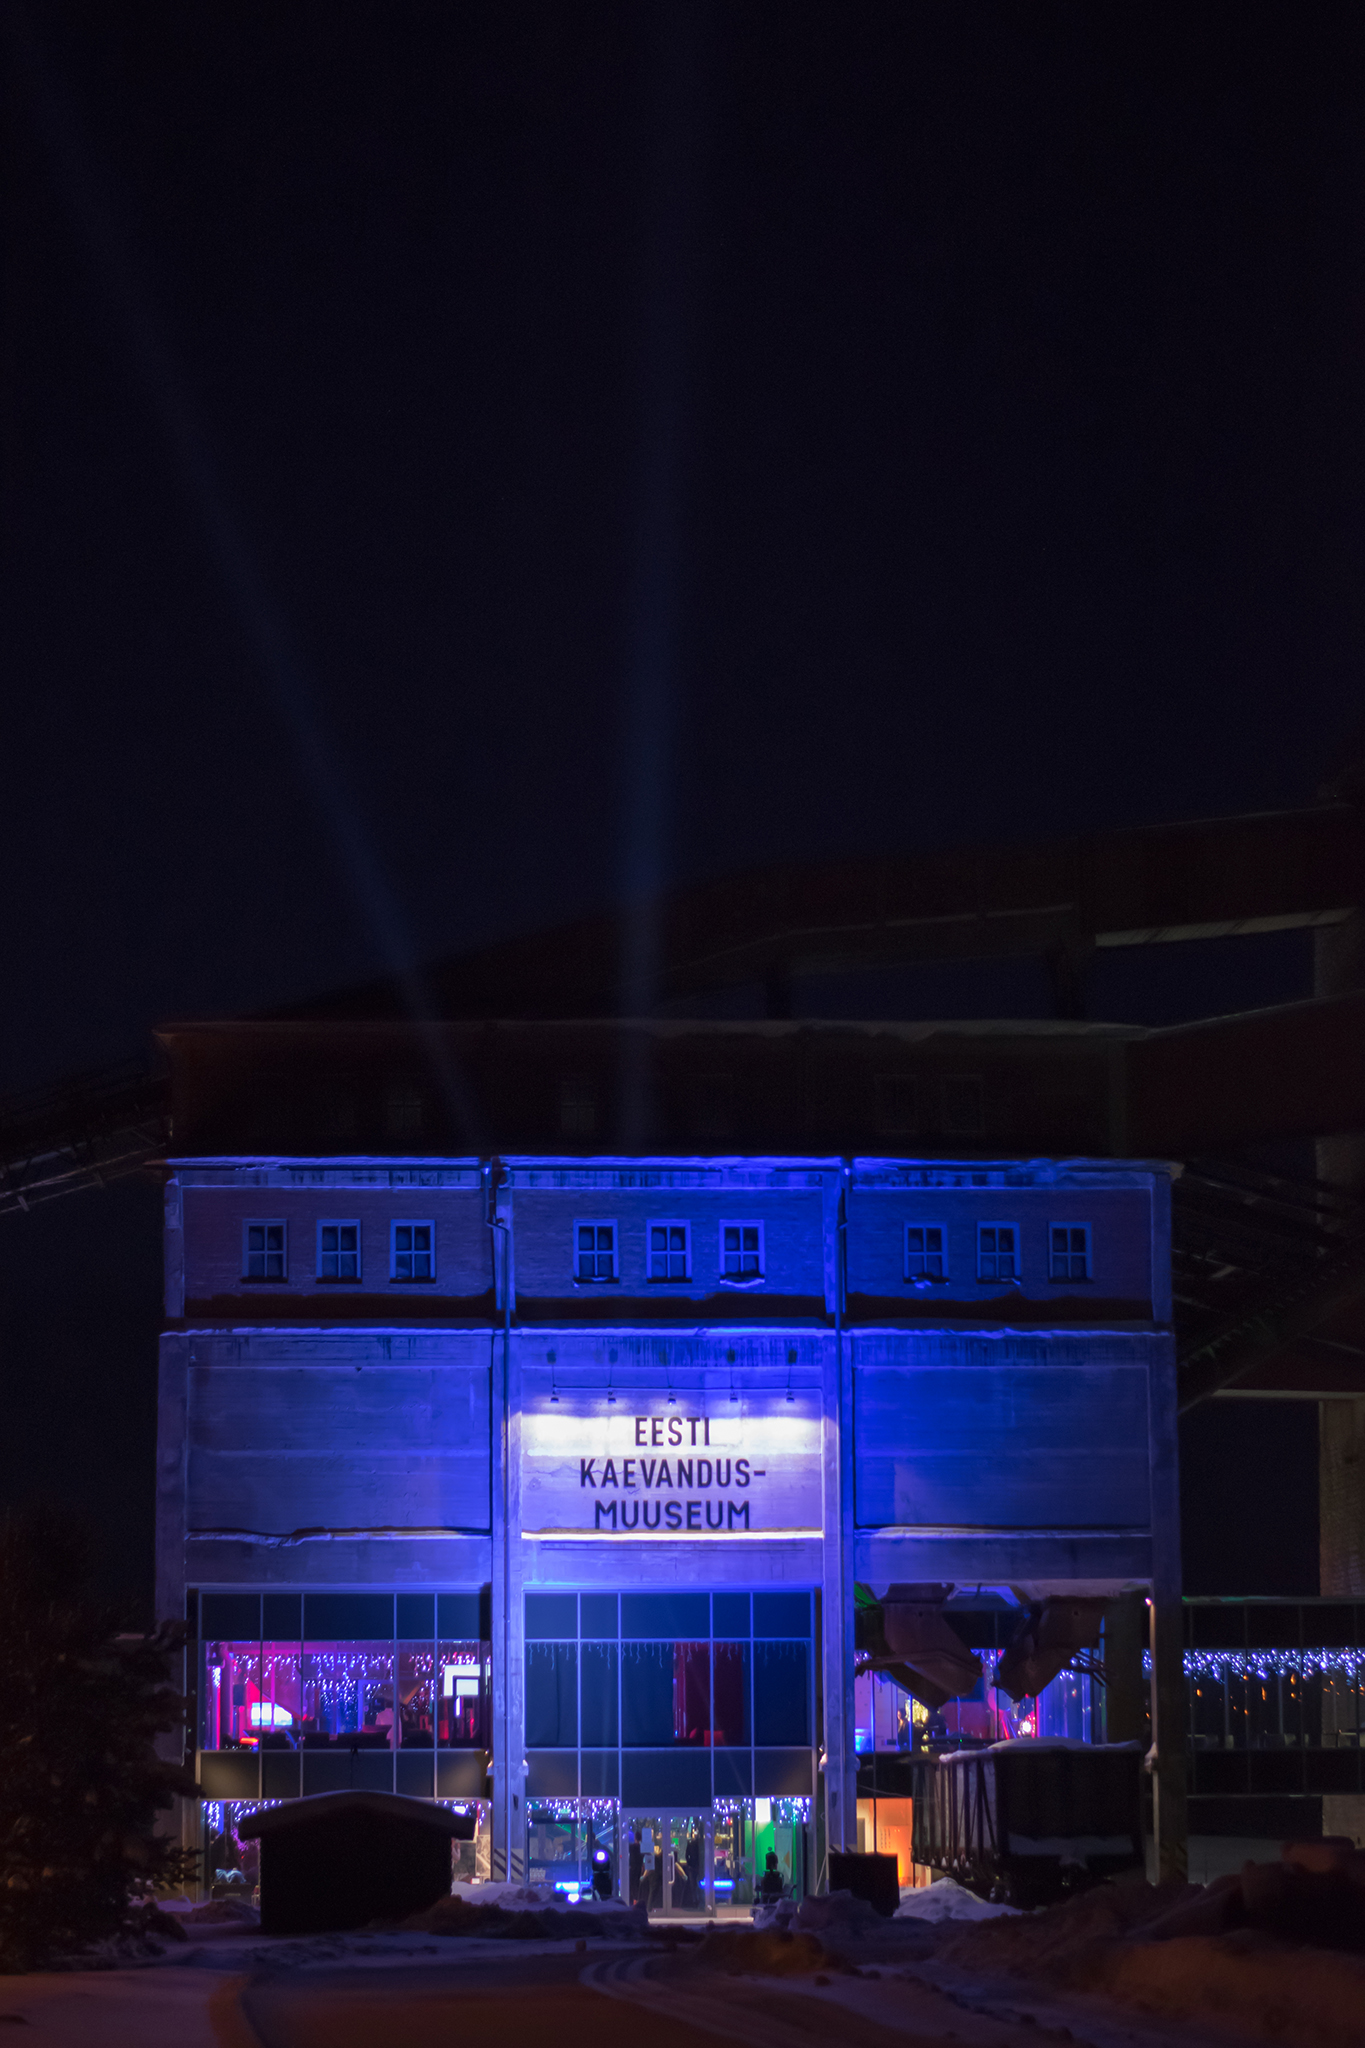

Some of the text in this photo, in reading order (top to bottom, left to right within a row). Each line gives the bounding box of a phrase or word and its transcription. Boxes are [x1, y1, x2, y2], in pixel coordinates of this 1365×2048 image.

[635, 1417, 710, 1446] EESTI
[580, 1458, 766, 1488] KAEVANDUS-
[594, 1500, 750, 1530] MUUSEUM
